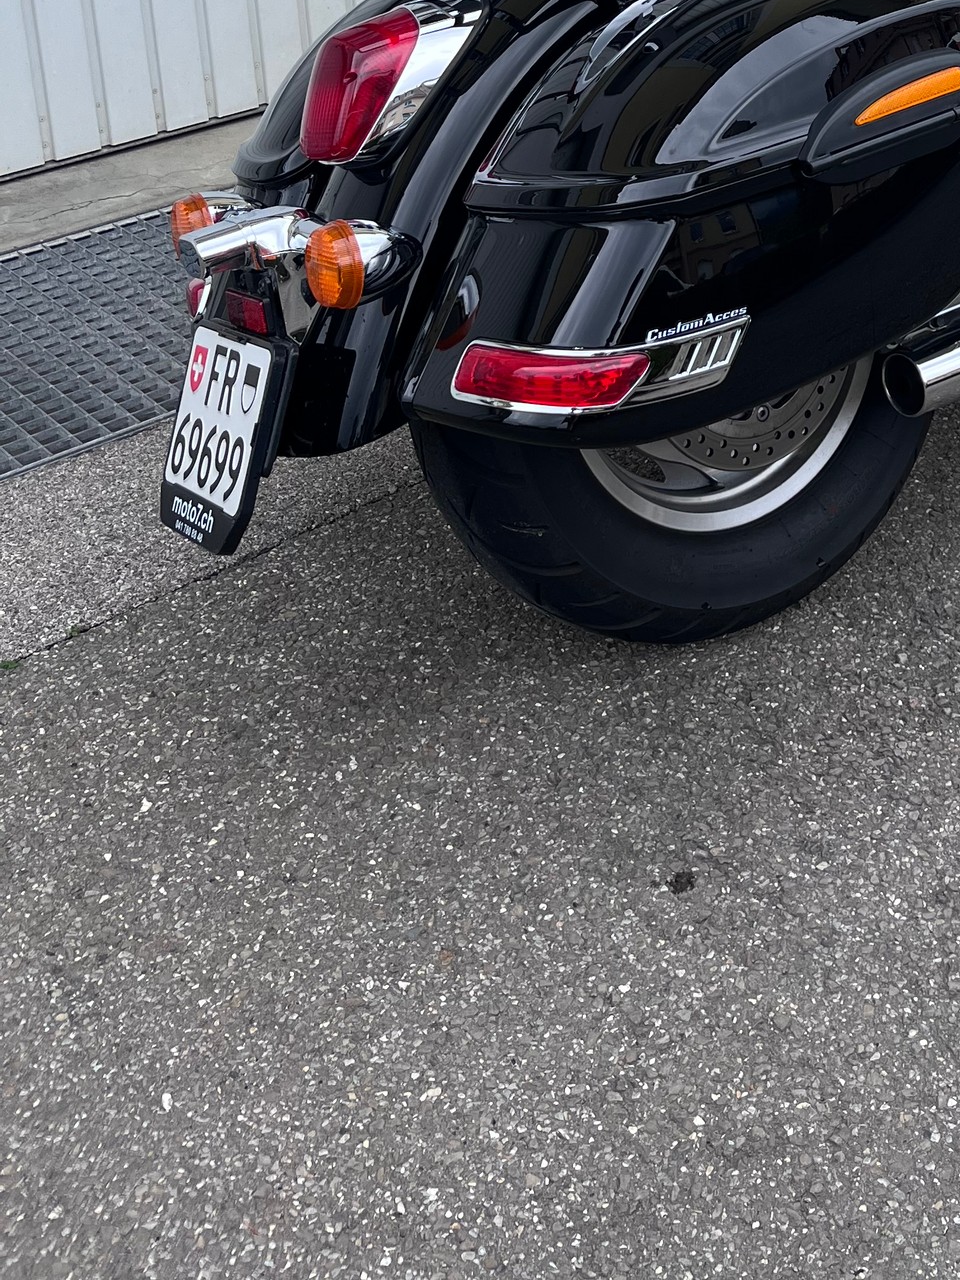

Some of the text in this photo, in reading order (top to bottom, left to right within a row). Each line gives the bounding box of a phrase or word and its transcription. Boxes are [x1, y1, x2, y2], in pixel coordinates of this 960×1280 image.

[647, 307, 747, 341] CustomAcces
[204, 344, 240, 415] FR
[171, 413, 244, 502] 69699
[172, 496, 214, 533] moto7.ch
